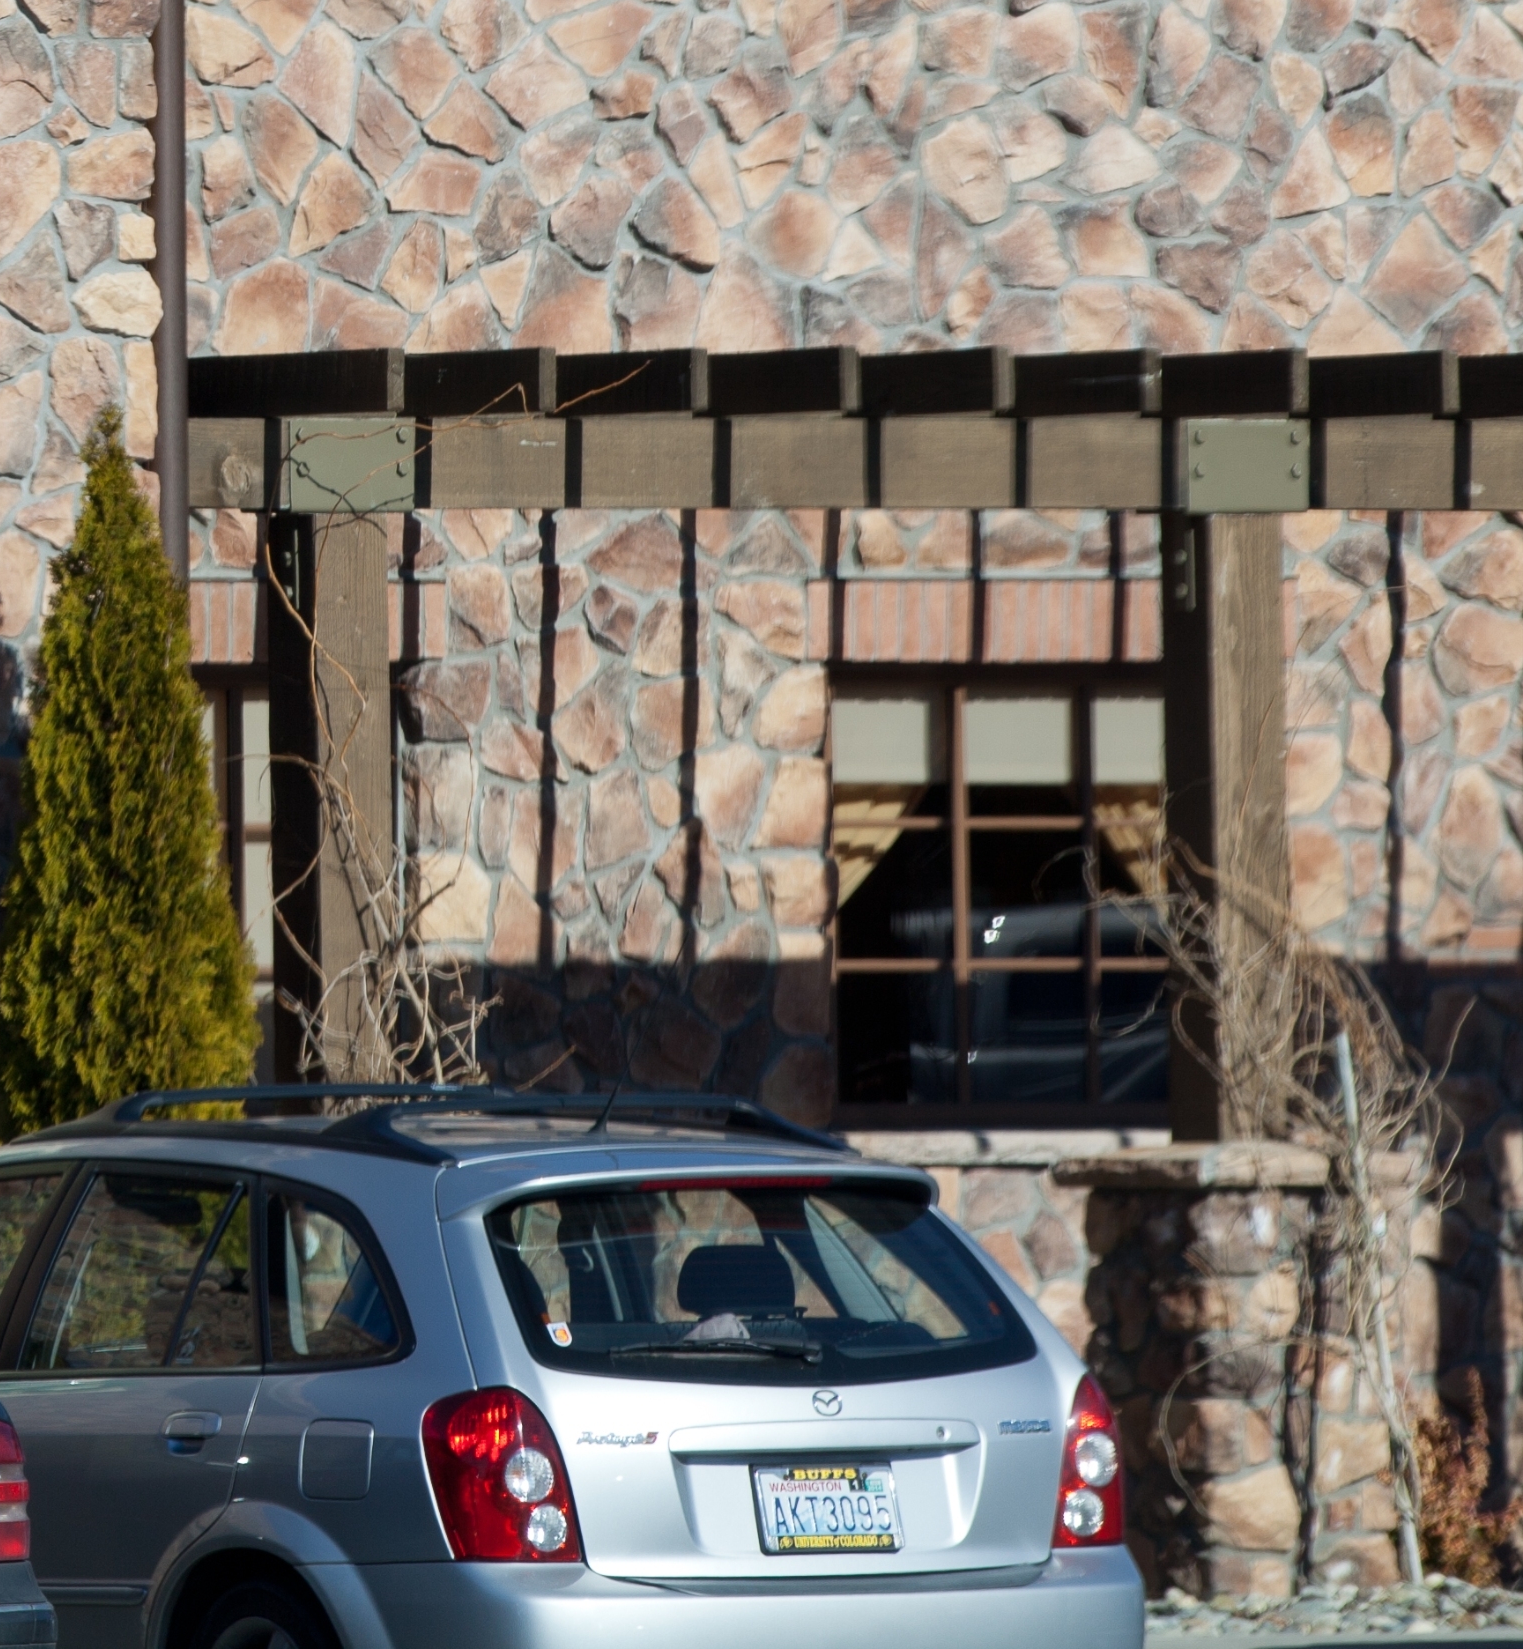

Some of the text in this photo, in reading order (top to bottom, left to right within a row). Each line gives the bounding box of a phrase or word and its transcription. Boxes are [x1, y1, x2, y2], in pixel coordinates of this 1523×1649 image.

[793, 1468, 857, 1480] BUFFS
[769, 1481, 842, 1493] WASHINGTON
[774, 1495, 892, 1534] AKT3095
[793, 1535, 834, 1548] UNIVERSITY
[840, 1535, 879, 1548] COLORADO
